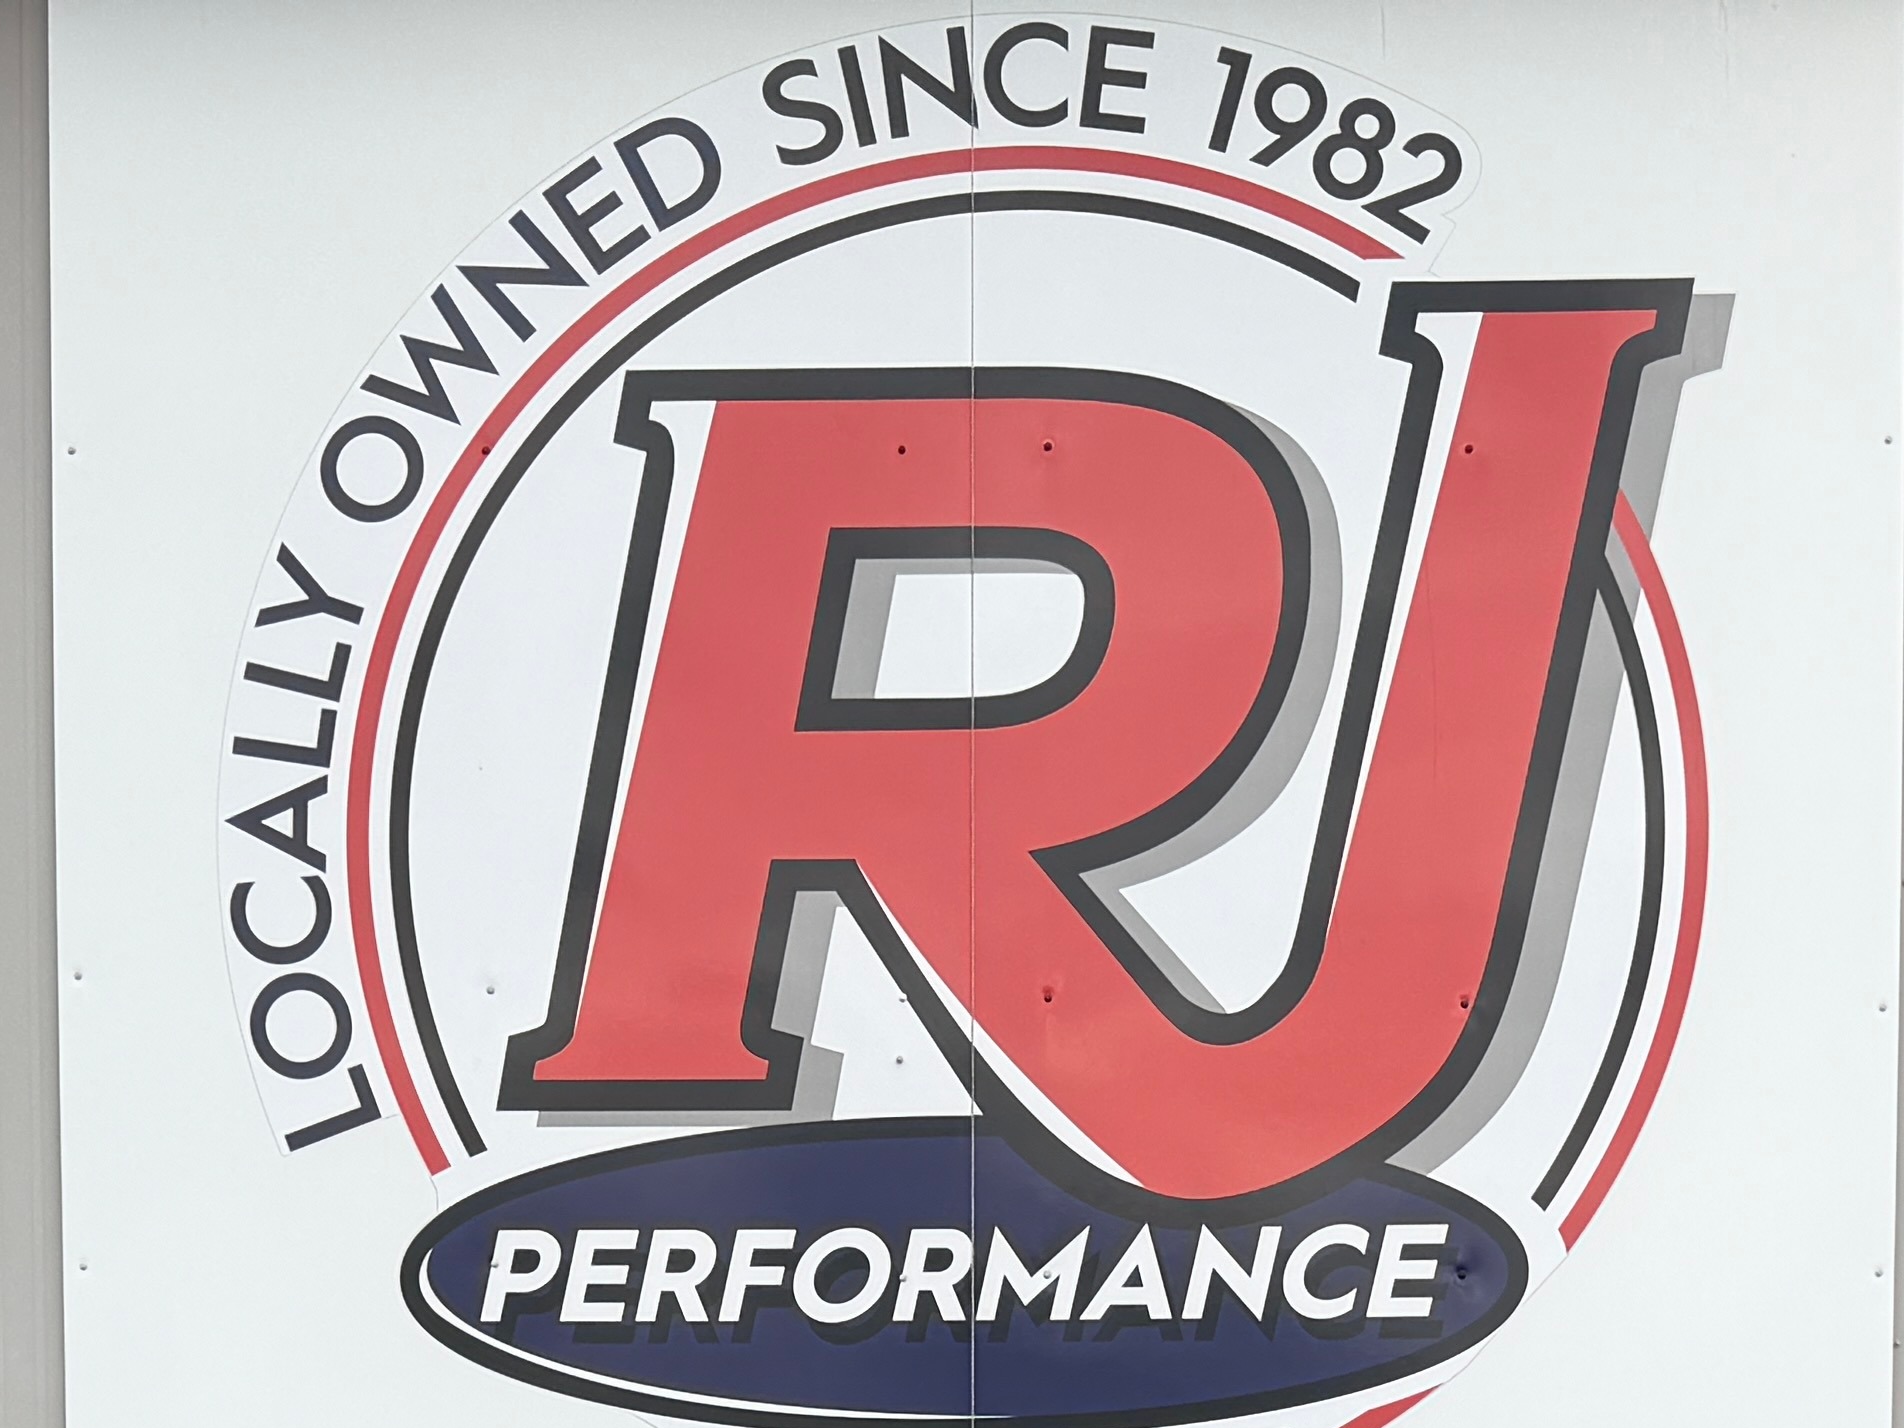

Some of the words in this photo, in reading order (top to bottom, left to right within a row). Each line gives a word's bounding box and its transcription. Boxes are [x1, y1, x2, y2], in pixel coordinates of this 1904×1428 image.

[225, 542, 382, 1152] LOCALLY
[319, 116, 722, 523] OWNED
[761, 22, 1156, 165] SINCE
[1208, 45, 1464, 245] 1982
[497, 278, 1696, 1224] RJ
[479, 1221, 1449, 1325] PERFORMANCE
